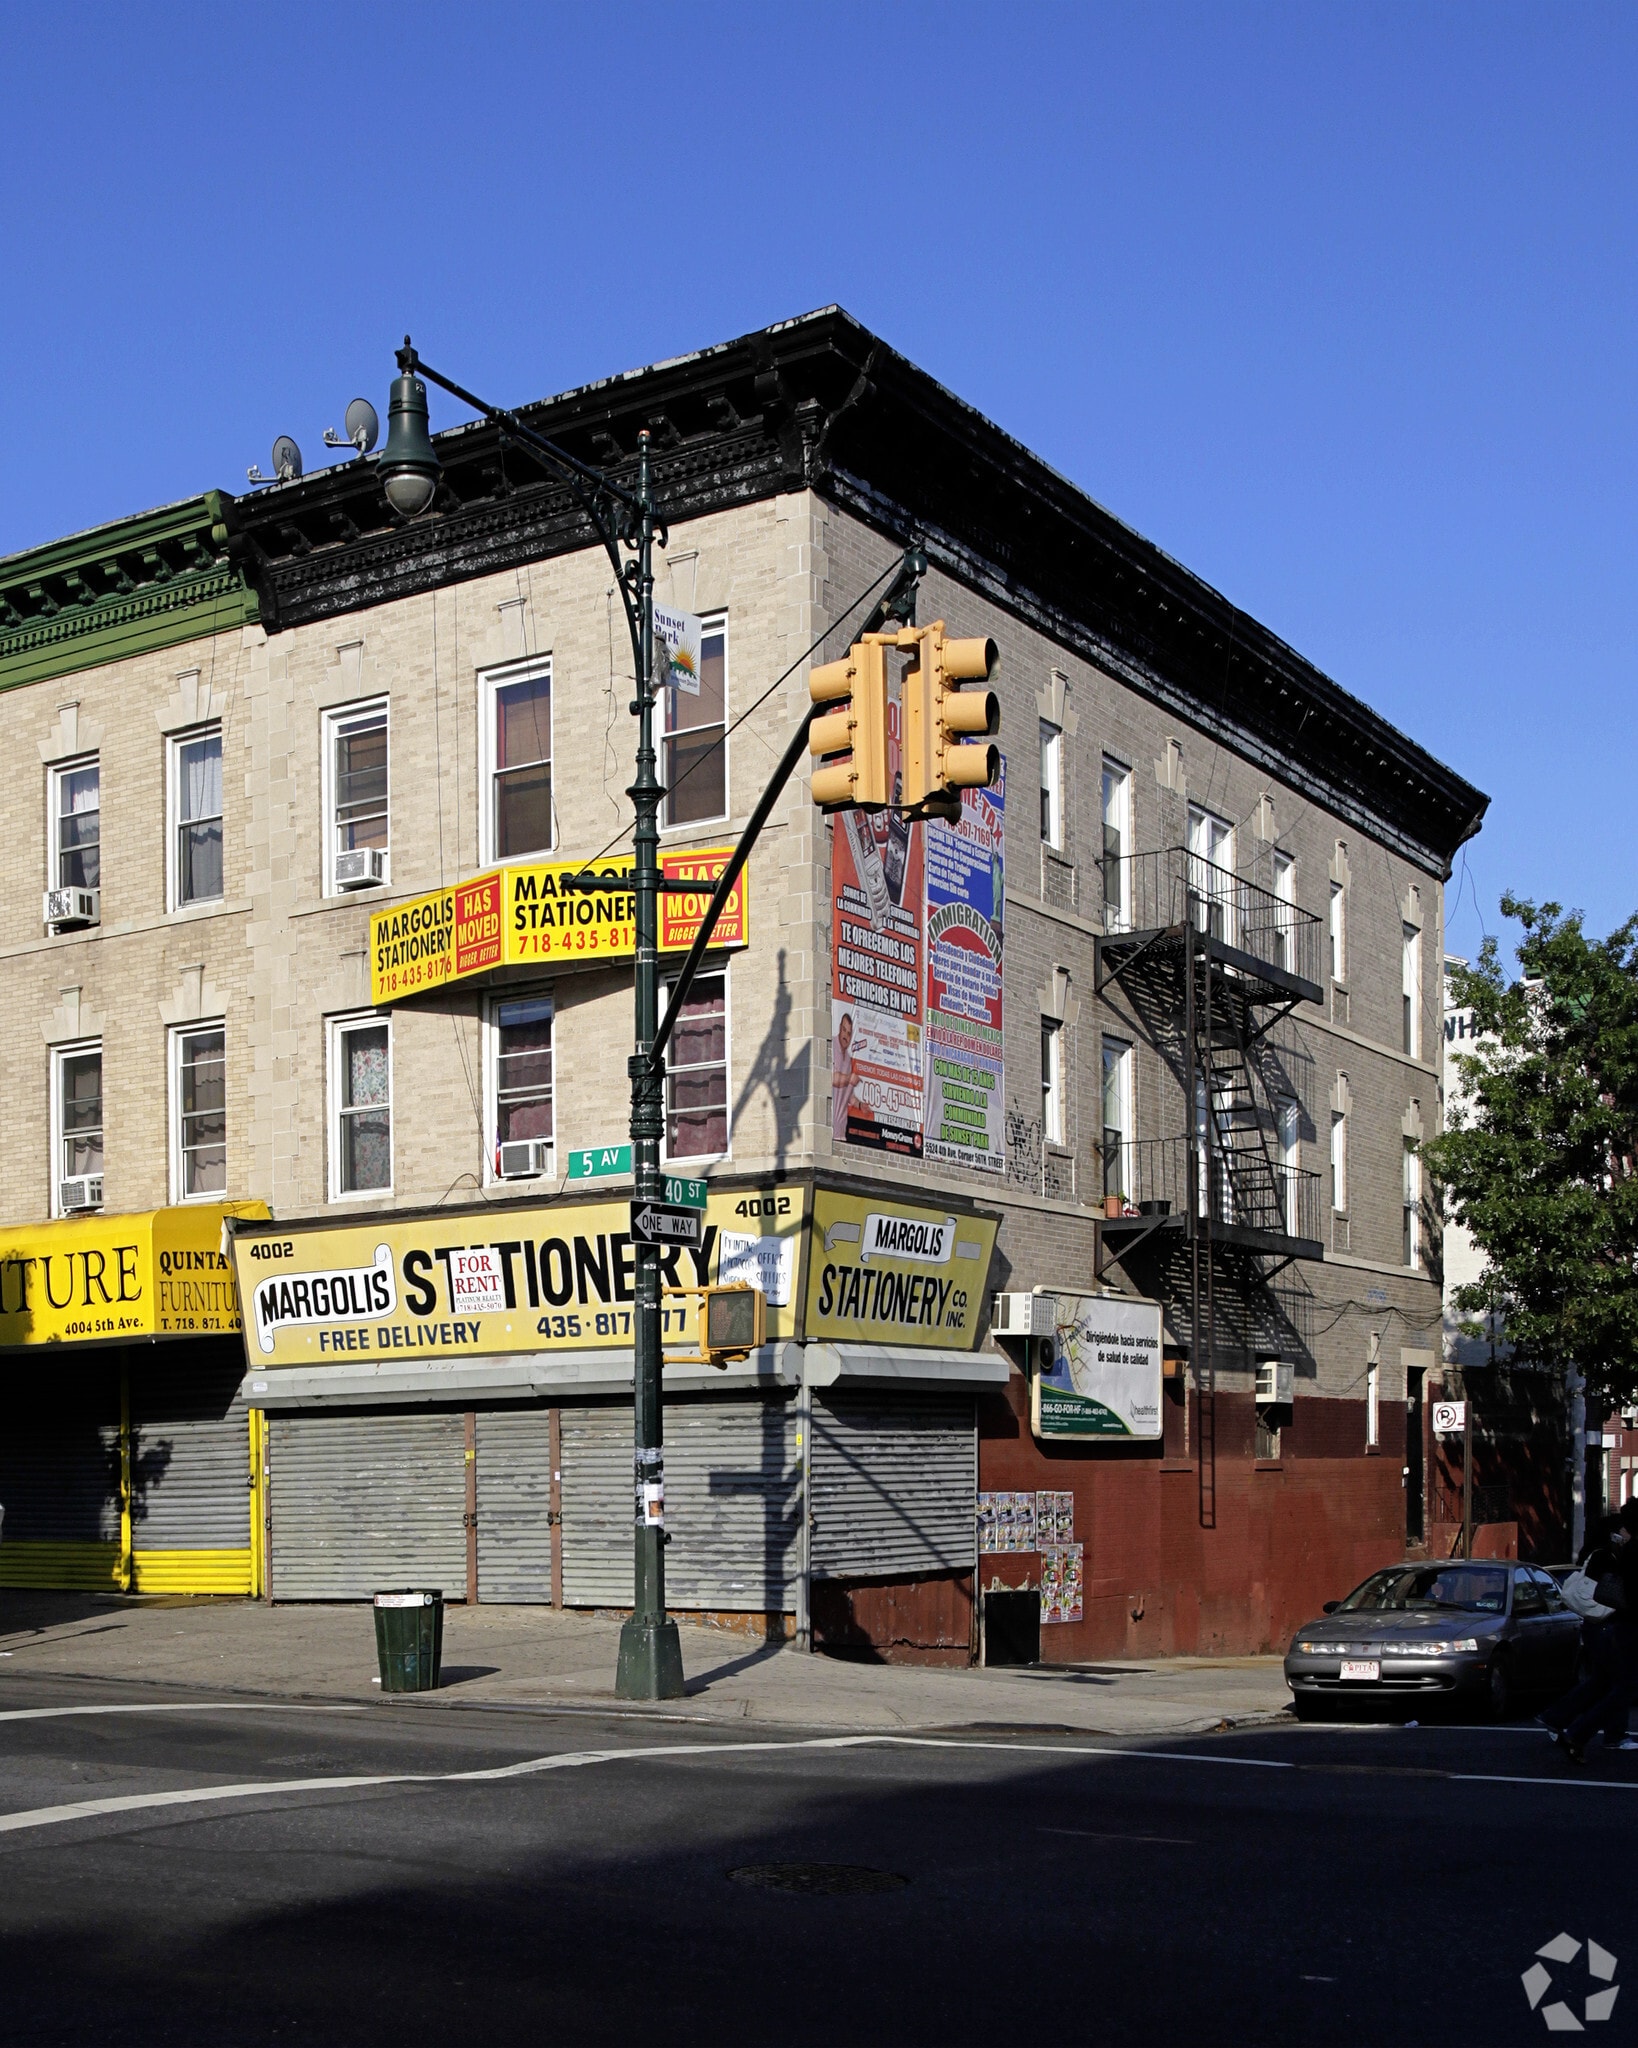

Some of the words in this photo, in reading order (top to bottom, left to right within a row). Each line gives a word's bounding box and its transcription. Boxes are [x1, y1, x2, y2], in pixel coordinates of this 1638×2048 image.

[654, 608, 685, 633] Sunset
[464, 888, 492, 919] HAS
[667, 890, 739, 918] MOVD
[836, 897, 844, 911] LA
[859, 891, 867, 905] DE
[377, 896, 453, 946] MARGOLIS
[458, 912, 499, 947] MOVED
[841, 921, 852, 944] TE
[852, 925, 900, 960] OFRECEMOS
[900, 942, 915, 966] LOS
[928, 904, 1002, 964] IMMIGRATION
[377, 925, 453, 973] STATIONERY
[479, 944, 499, 963] BETTER
[379, 956, 452, 995] 718-435-8176
[838, 945, 875, 977] MEJORES
[875, 958, 918, 992] TELEFONOS
[954, 974, 961, 986] de
[839, 971, 846, 994] Y
[846, 976, 889, 1006] SERVICIOS
[889, 988, 900, 1011] EN
[900, 992, 917, 1017] NYC
[961, 990, 968, 1001] de
[941, 1123, 949, 1141] DE
[949, 1126, 973, 1147] SUNSET
[925, 1142, 938, 1154] 5524
[582, 1152, 593, 1176] 5
[601, 1149, 619, 1168] AV
[665, 1179, 683, 1203] 40
[688, 1183, 701, 1199] ST
[735, 1196, 792, 1218] 4002
[641, 1213, 663, 1232] ONE
[671, 1217, 693, 1235] WAY
[875, 1219, 944, 1257] MARGOLIS
[250, 1241, 295, 1260] 4002
[159, 1251, 228, 1276] QUINTA
[402, 1225, 719, 1317] STTIONERY
[458, 1255, 493, 1274] FOR
[455, 1274, 501, 1295] RENT
[818, 1263, 954, 1327] STATIONERY
[259, 1269, 390, 1326] MARGOLIS
[482, 1294, 502, 1303] REALTY
[952, 1289, 968, 1308] CO.
[65, 1321, 92, 1336] 4004
[95, 1317, 114, 1332] 5th
[117, 1316, 144, 1330] Ave.
[160, 1318, 172, 1330] T.
[175, 1318, 199, 1330] 718.
[202, 1317, 225, 1330] 871.
[946, 1310, 966, 1329] INC.
[319, 1328, 370, 1352] FREE
[377, 1321, 482, 1350] DELIVERY
[1120, 1333, 1135, 1347] hacia
[1136, 1336, 1158, 1349] servicios
[1098, 1349, 1105, 1362] de
[1106, 1351, 1121, 1363] salud
[1122, 1352, 1129, 1364] de
[1130, 1353, 1149, 1365] calidad
